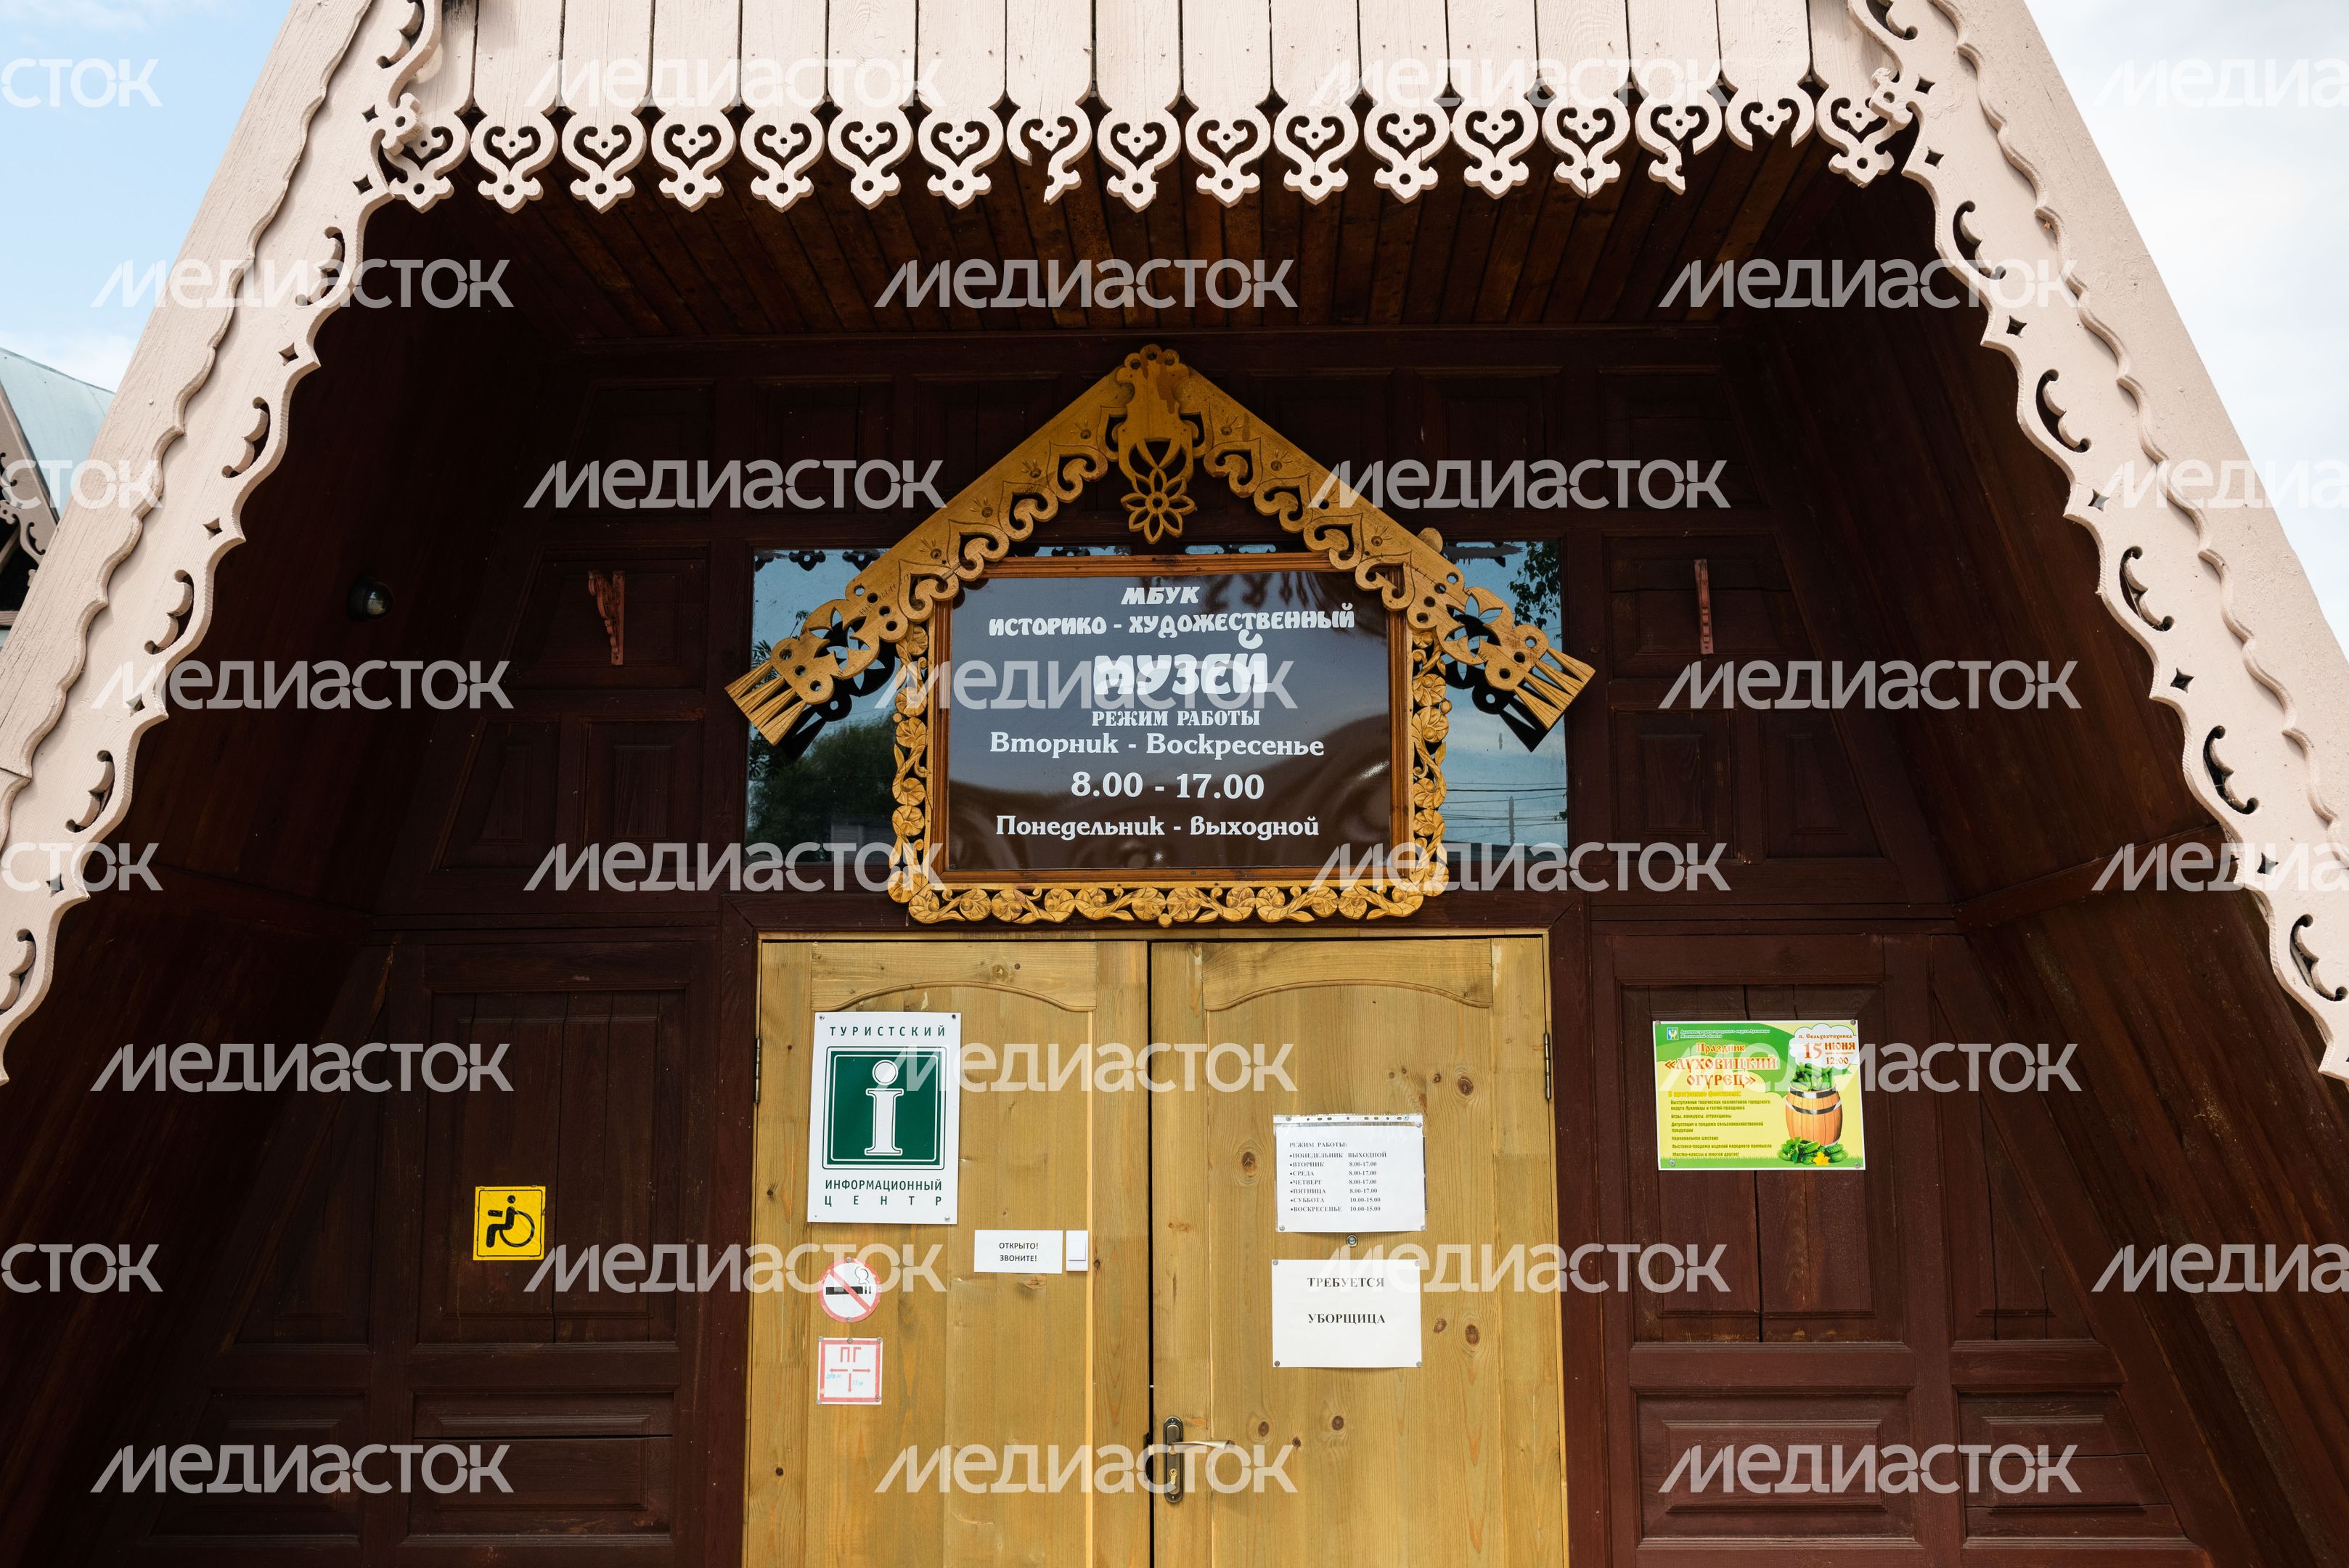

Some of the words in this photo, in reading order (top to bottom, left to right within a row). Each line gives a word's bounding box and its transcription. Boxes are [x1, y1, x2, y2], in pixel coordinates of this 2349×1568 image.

[1121, 586, 1200, 605] МБУК
[989, 617, 1107, 637] ИСТОРИКО
[1129, 603, 1355, 639] ХУДОЖЕСТВЕННЫЙ
[1094, 629, 1268, 696] МУЗЕЙ
[1092, 711, 1169, 727] РЕЖИМ
[1177, 710, 1260, 727] РАБОТЫ
[990, 732, 1119, 759] Вторник
[1147, 734, 1324, 760] Воскресенье
[1071, 771, 1143, 798] 8.00
[1177, 773, 1265, 799] 17.00
[996, 815, 1165, 840] Понедельник
[830, 1024, 946, 1037] ТУРИСТСКИЙ
[1696, 1043, 1745, 1054] Праздник
[1804, 1042, 1823, 1059] 15
[1826, 1056, 1849, 1065] 12:00
[825, 1177, 942, 1193] ИНФОРМАЦИОННЫЙ
[999, 1241, 1039, 1250] ОТКРЫТО!
[1000, 1254, 1037, 1262] ЗВОНИТЕ!
[1307, 1277, 1384, 1287] ТРЕБУЕТСЯ
[1307, 1313, 1386, 1324] УБОРЩИЦА
[840, 1347, 862, 1363] ПГ
